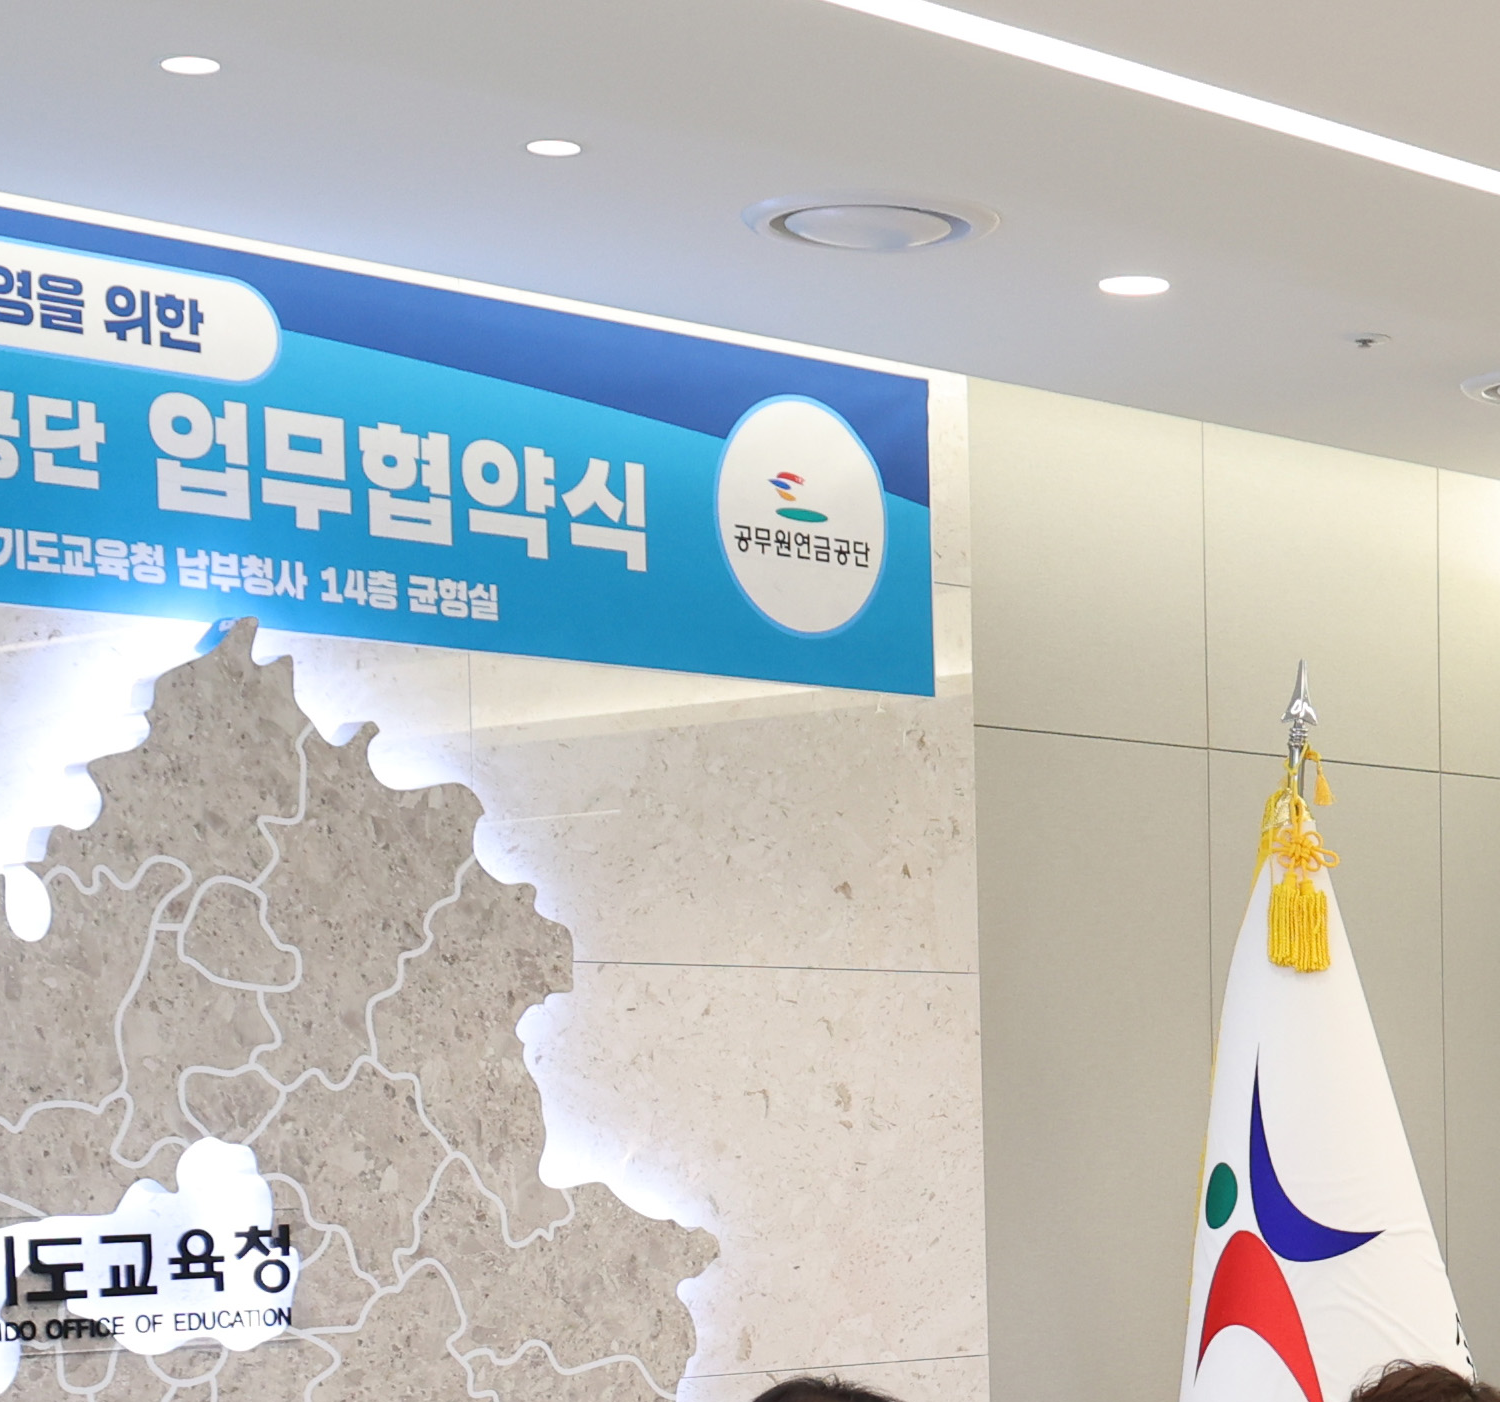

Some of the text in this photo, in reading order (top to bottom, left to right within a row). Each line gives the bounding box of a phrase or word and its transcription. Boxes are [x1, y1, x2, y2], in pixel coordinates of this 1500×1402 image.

[104, 283, 205, 354] 위한
[148, 392, 648, 575] 업무협약식
[732, 523, 871, 571] 공무원연금공단
[176, 547, 308, 600] 남부청사
[321, 566, 398, 611] 14층
[407, 575, 499, 622] 균형실
[46, 1316, 125, 1340] OFFICE
[135, 1313, 163, 1333] OF
[174, 1306, 292, 1332] EDUCATION
